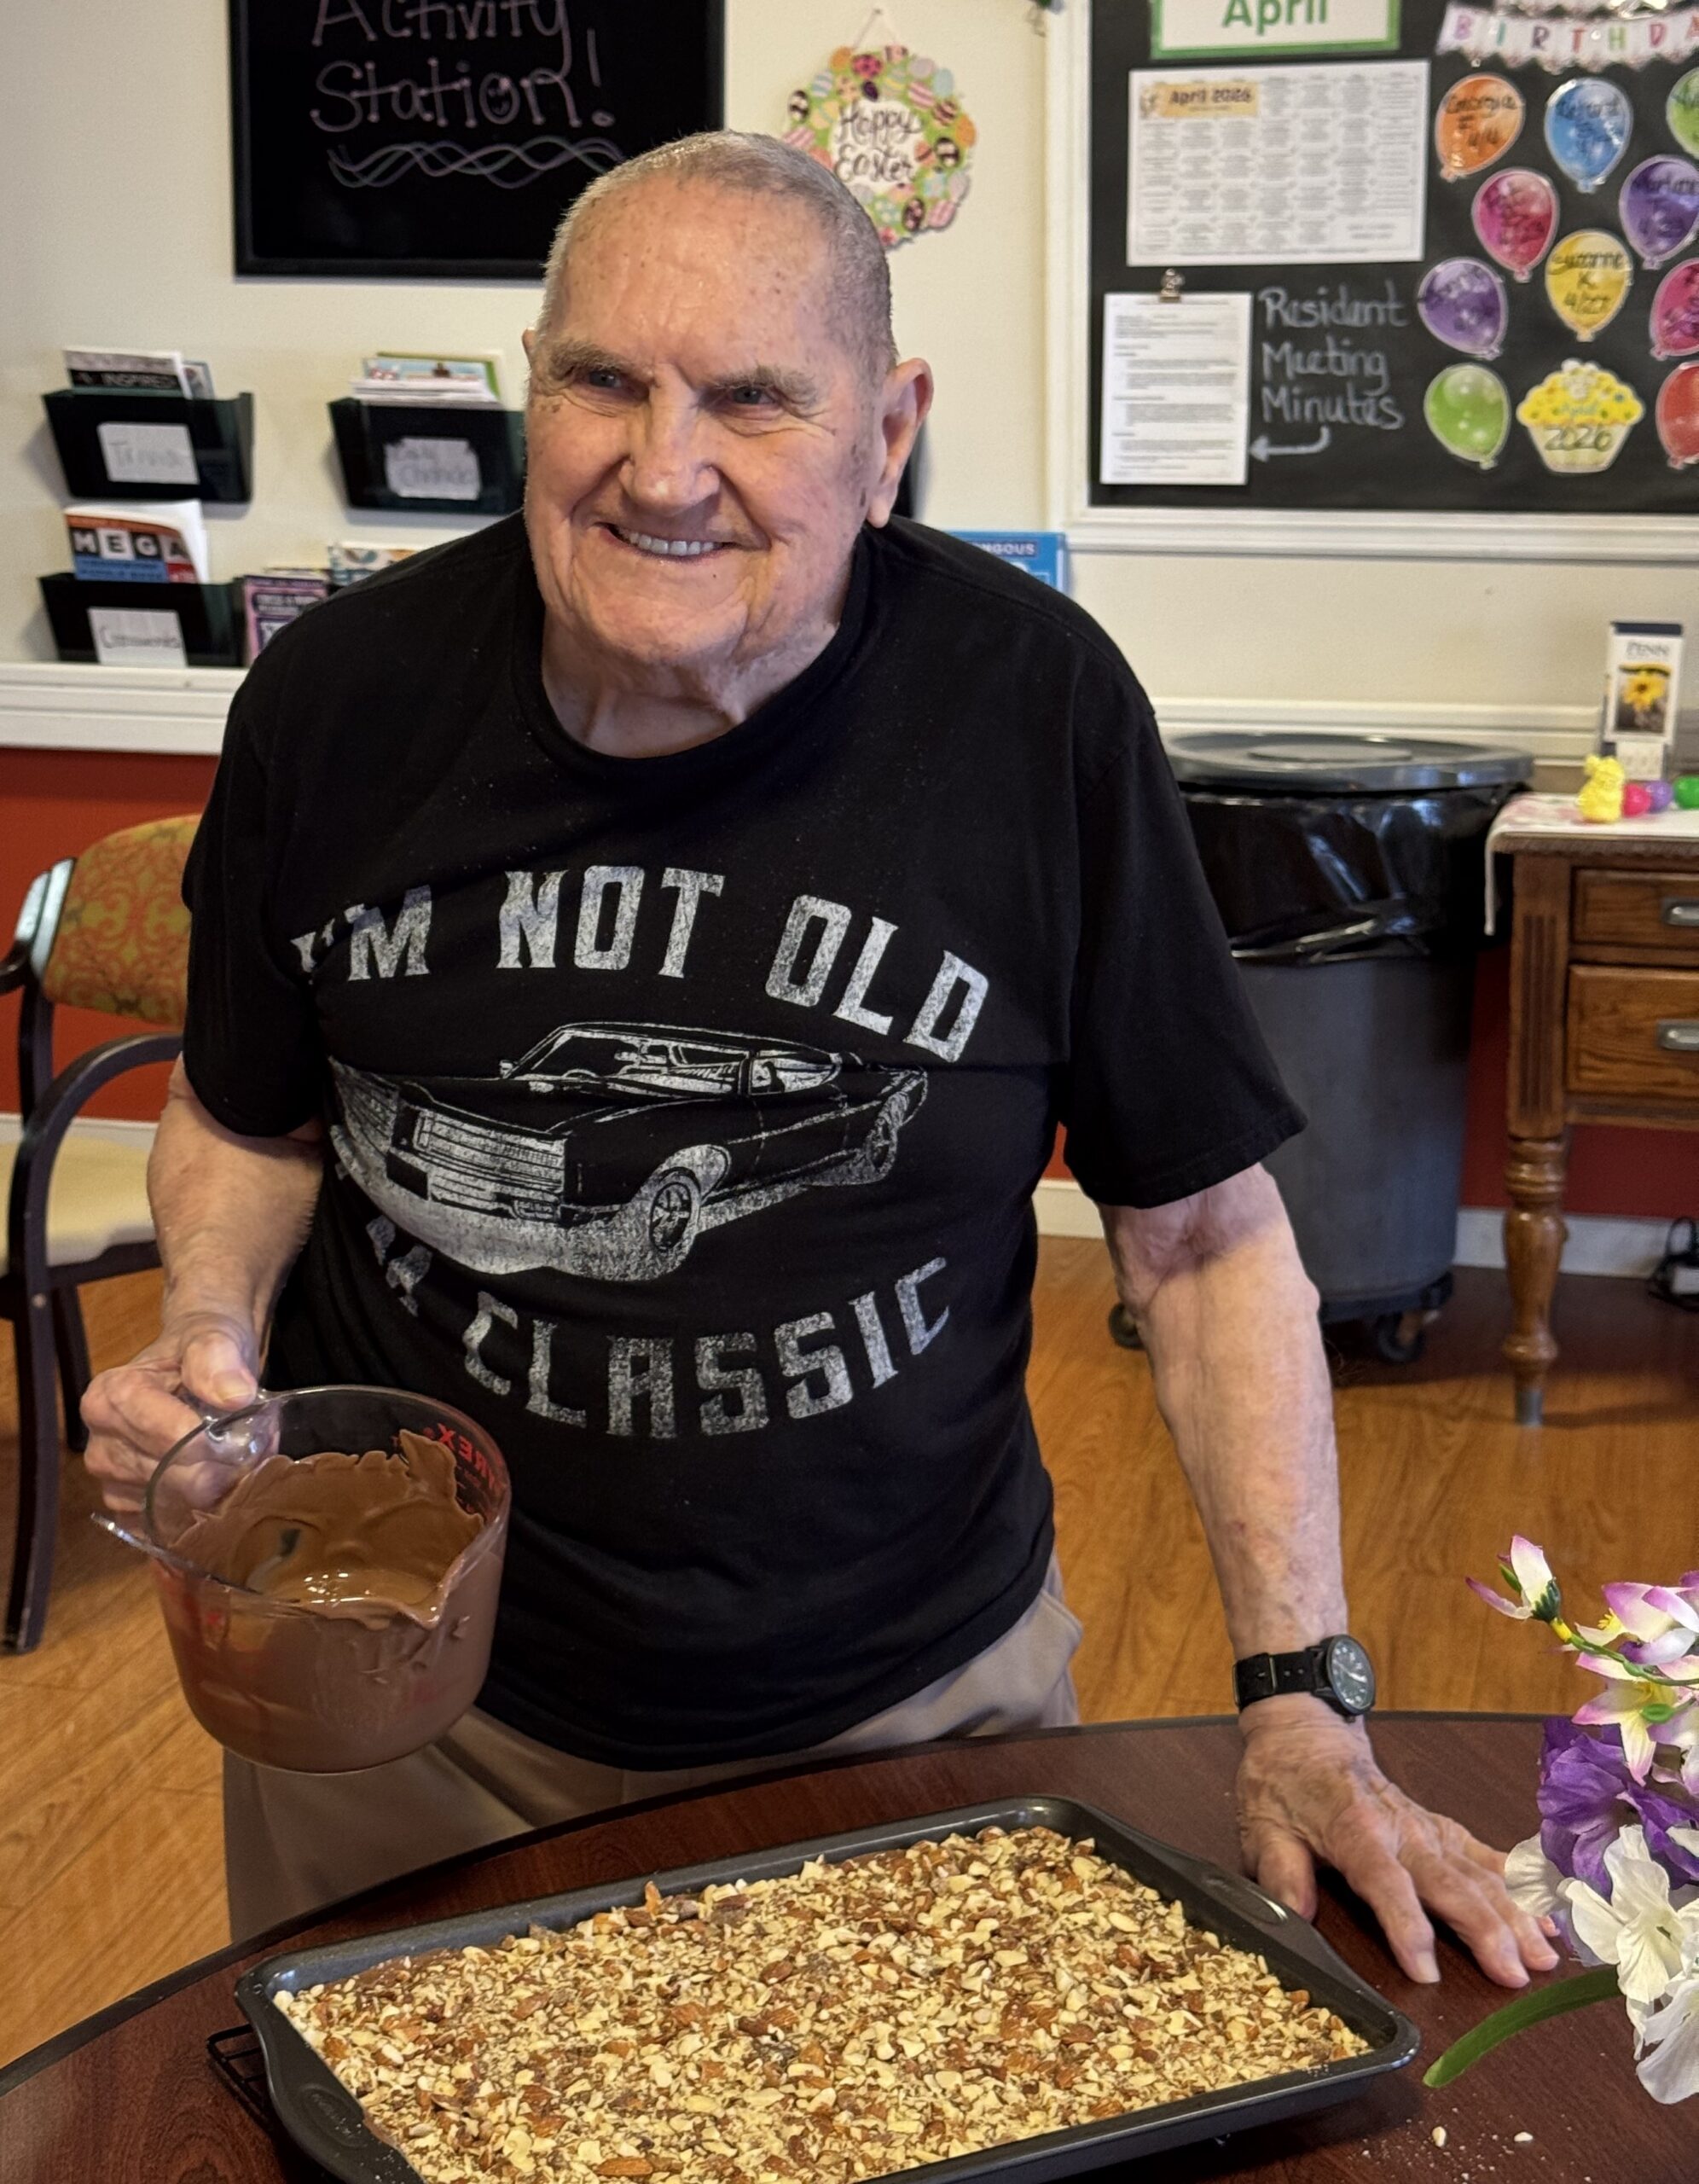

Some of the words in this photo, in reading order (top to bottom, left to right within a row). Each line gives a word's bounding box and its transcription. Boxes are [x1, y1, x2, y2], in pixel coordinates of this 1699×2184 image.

[310, 0, 572, 81] Activity
[1221, 0, 1328, 36] April
[836, 100, 922, 145] Happy
[834, 144, 915, 182] Easter
[1258, 279, 1409, 330] Resident
[1261, 335, 1391, 396] Meeting
[1261, 382, 1404, 430] Minutes
[73, 530, 190, 559] MEGA
[496, 865, 726, 979] NOT
[765, 894, 989, 1063] OLD
[462, 1257, 949, 1440] CLASSIC
